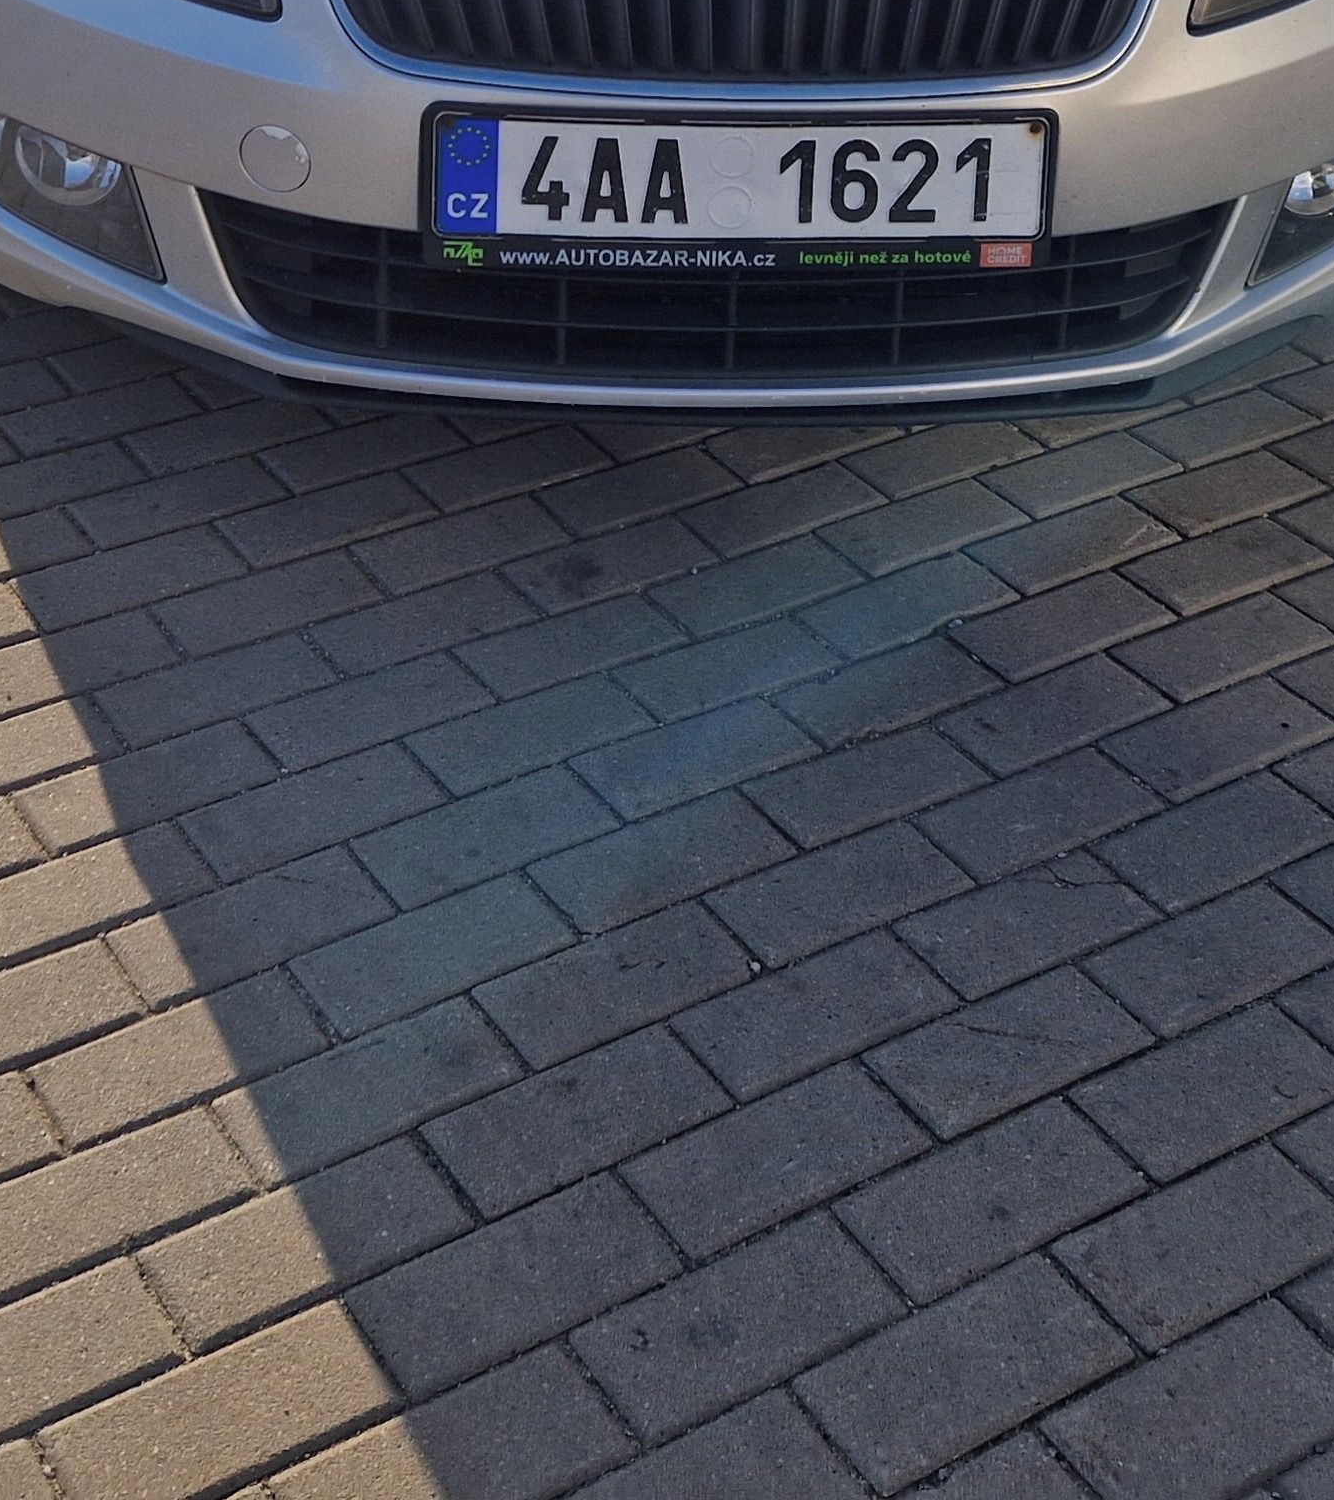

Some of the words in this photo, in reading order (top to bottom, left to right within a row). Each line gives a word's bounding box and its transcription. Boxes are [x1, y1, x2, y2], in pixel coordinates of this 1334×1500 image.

[520, 136, 688, 223] 4AA
[779, 138, 994, 224] 1621
[446, 192, 489, 219] CZ
[499, 248, 776, 267] www.AUTOBAZAR-NIKA.cz
[799, 251, 854, 267] levněji
[859, 251, 888, 264] než
[891, 253, 909, 264] za
[914, 250, 971, 264] hotové
[987, 255, 1027, 264] CREDIT
[988, 246, 1023, 256] HOME
